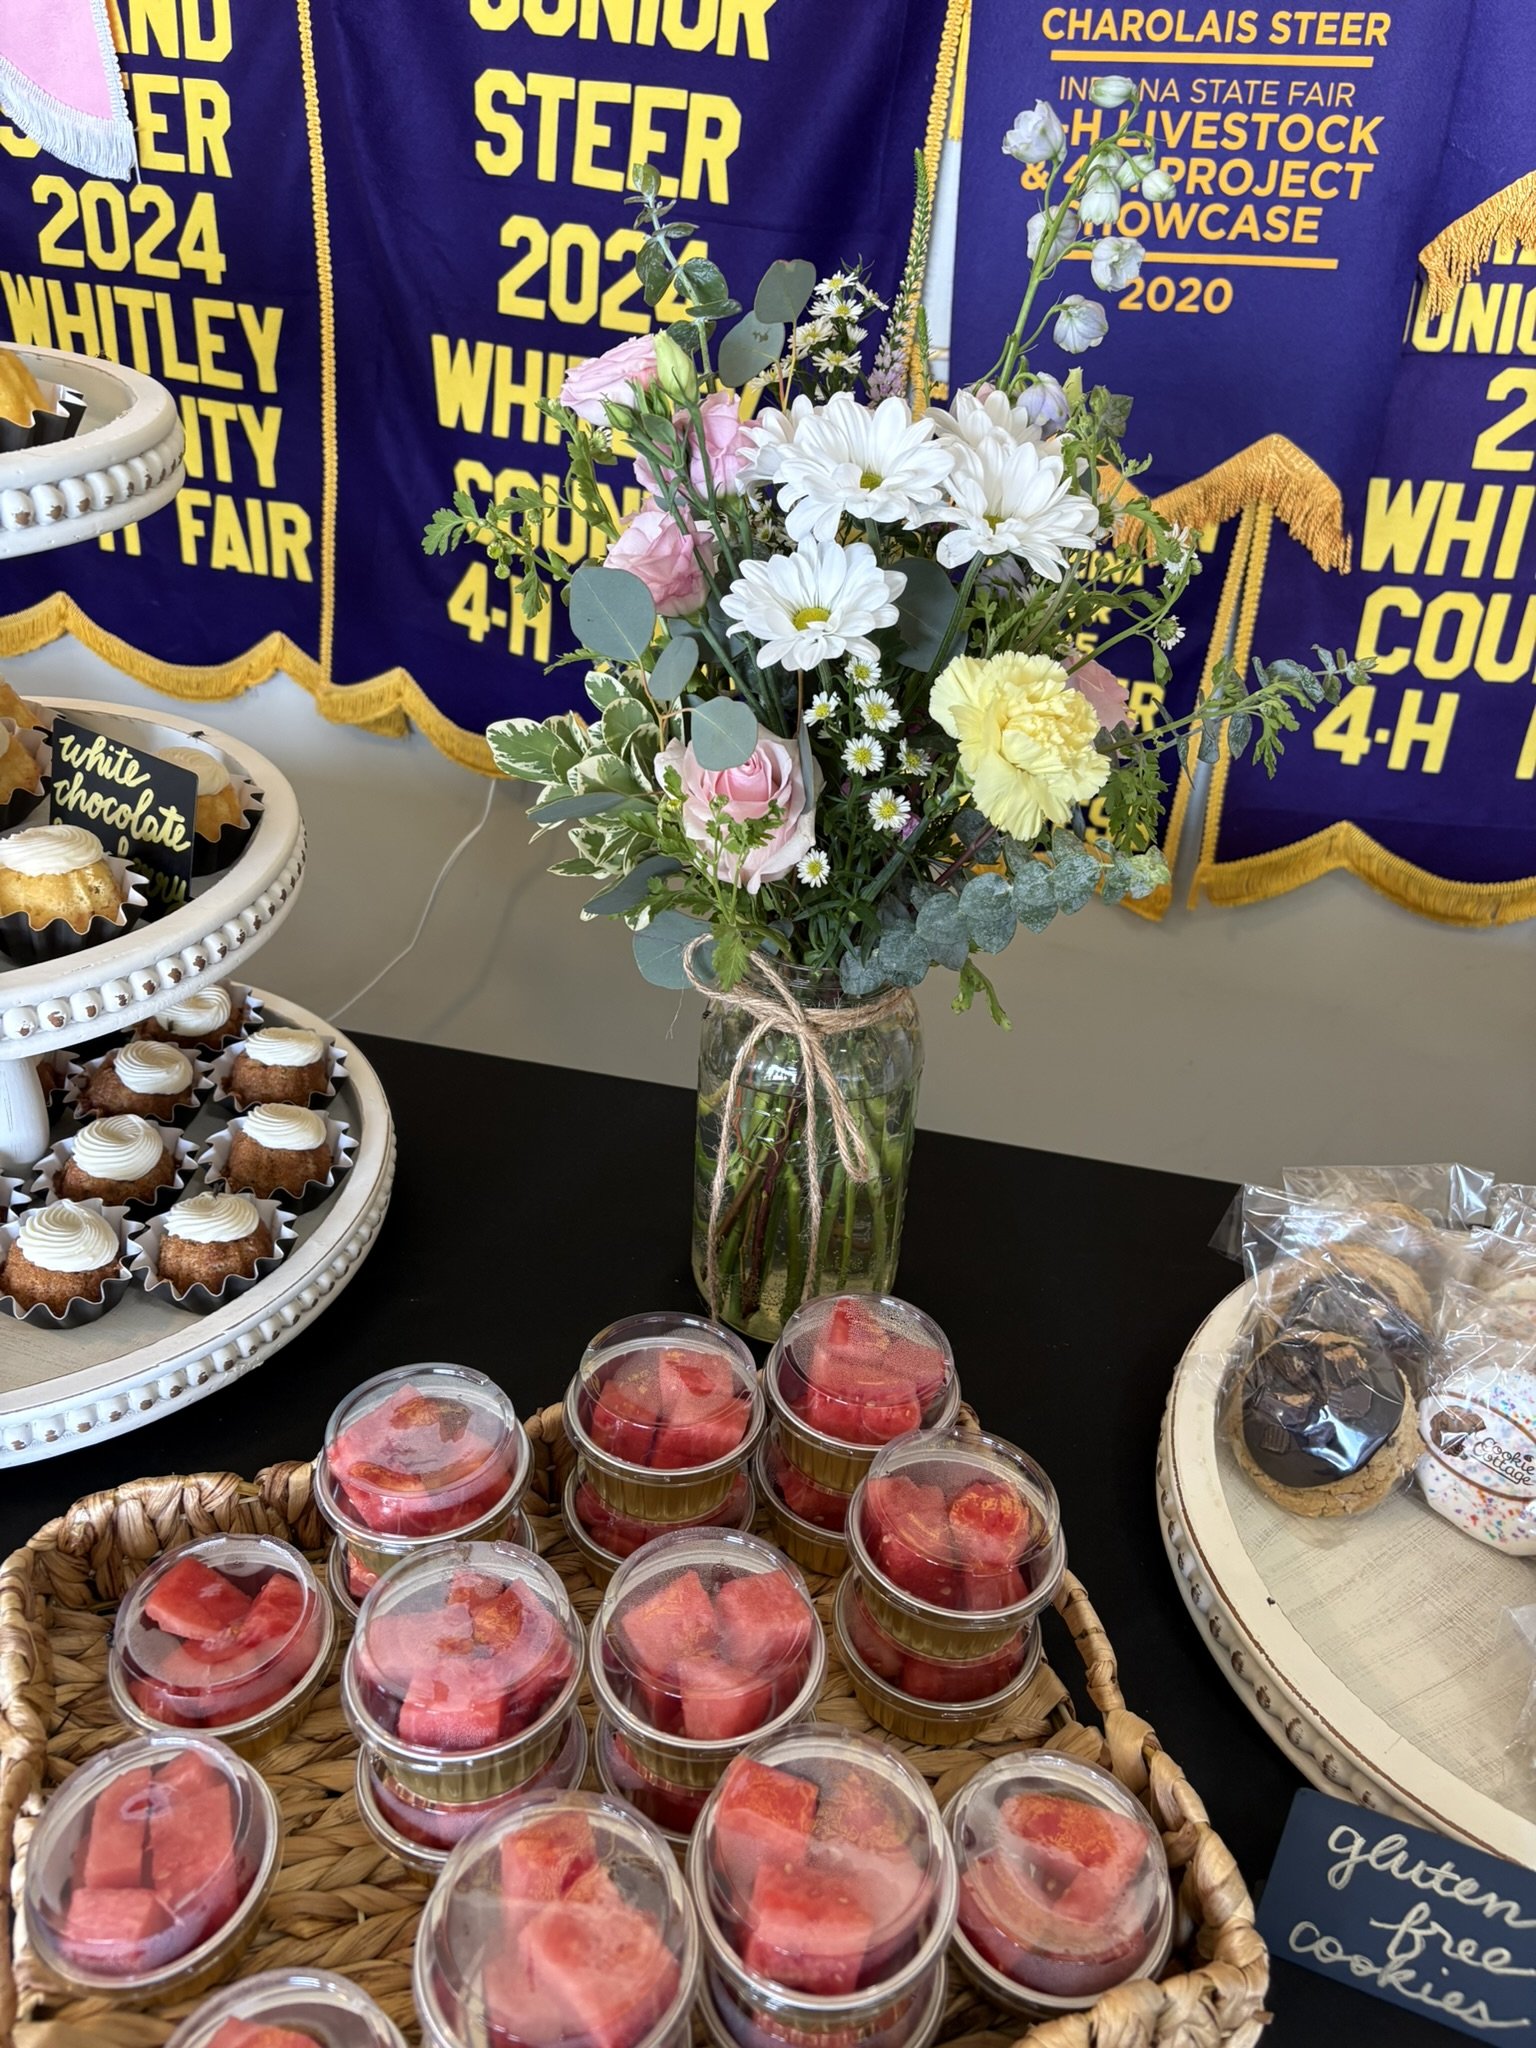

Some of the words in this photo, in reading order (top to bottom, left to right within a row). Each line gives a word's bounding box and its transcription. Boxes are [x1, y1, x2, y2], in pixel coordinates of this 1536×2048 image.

[1042, 8, 1258, 44] CHAROLAIS
[1270, 11, 1392, 47] STEER
[1190, 79, 1280, 106] STATE
[1288, 81, 1356, 107] FAIR
[474, 68, 743, 206] STEER
[1117, 110, 1385, 155] LIVESTOCK
[1020, 160, 1049, 191] &
[1159, 157, 1374, 200] PROJECT
[31, 174, 227, 285] 2024
[1064, 200, 1323, 244] OWCASE
[497, 214, 710, 332] 2024
[1118, 276, 1234, 314] 2020
[0, 270, 284, 393] WHITLEY
[176, 487, 313, 583] FAIR
[447, 561, 551, 664] 4-H
[59, 734, 150, 788] white
[1313, 685, 1460, 774] 4-H
[53, 772, 191, 852] chocolate
[1473, 1441, 1535, 1486] Cottage
[1482, 1437, 1535, 1476] Cookie
[1327, 1825, 1536, 1928] gluten
[1289, 1921, 1531, 2028] cookies
[1369, 1901, 1536, 1977] free
